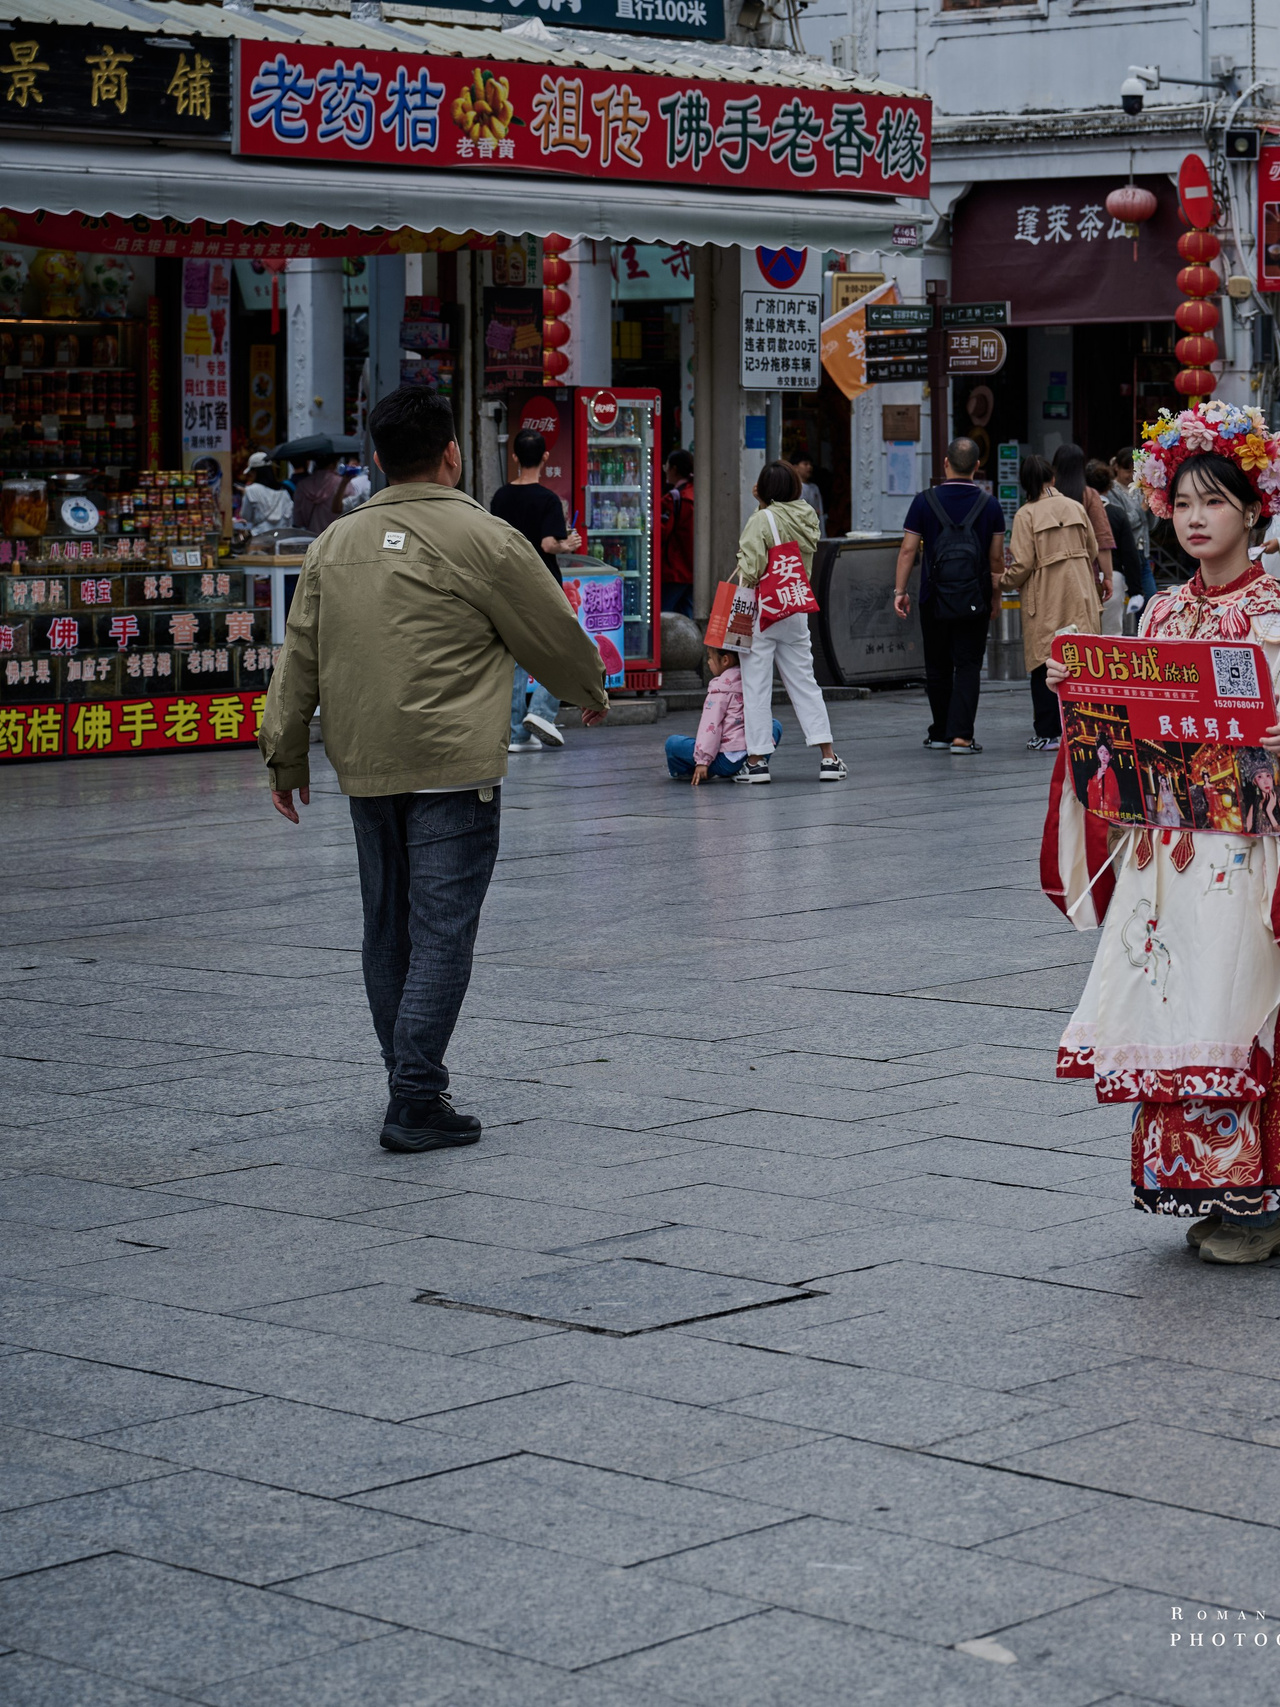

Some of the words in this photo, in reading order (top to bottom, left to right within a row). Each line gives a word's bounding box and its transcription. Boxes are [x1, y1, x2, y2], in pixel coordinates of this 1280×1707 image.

[0, 39, 213, 120] 景商铺
[248, 53, 445, 152] 老药桔
[456, 136, 515, 159] 老香黄
[755, 298, 817, 315] 广济门内广场
[745, 318, 812, 334] 禁止停放汽车、
[745, 337, 817, 354] 违者罚款200元
[951, 336, 979, 349] 卫生间
[745, 357, 811, 372] 记3分拖移车辆
[185, 379, 227, 397] 网红雪糕
[185, 402, 228, 430] 沙虾酱
[521, 416, 557, 432] 可口可乐
[191, 436, 222, 449] 潮州特产
[47, 611, 256, 650] 佛手香黄
[1214, 700, 1264, 710] 15207680477
[1158, 715, 1244, 741] 民族写真
